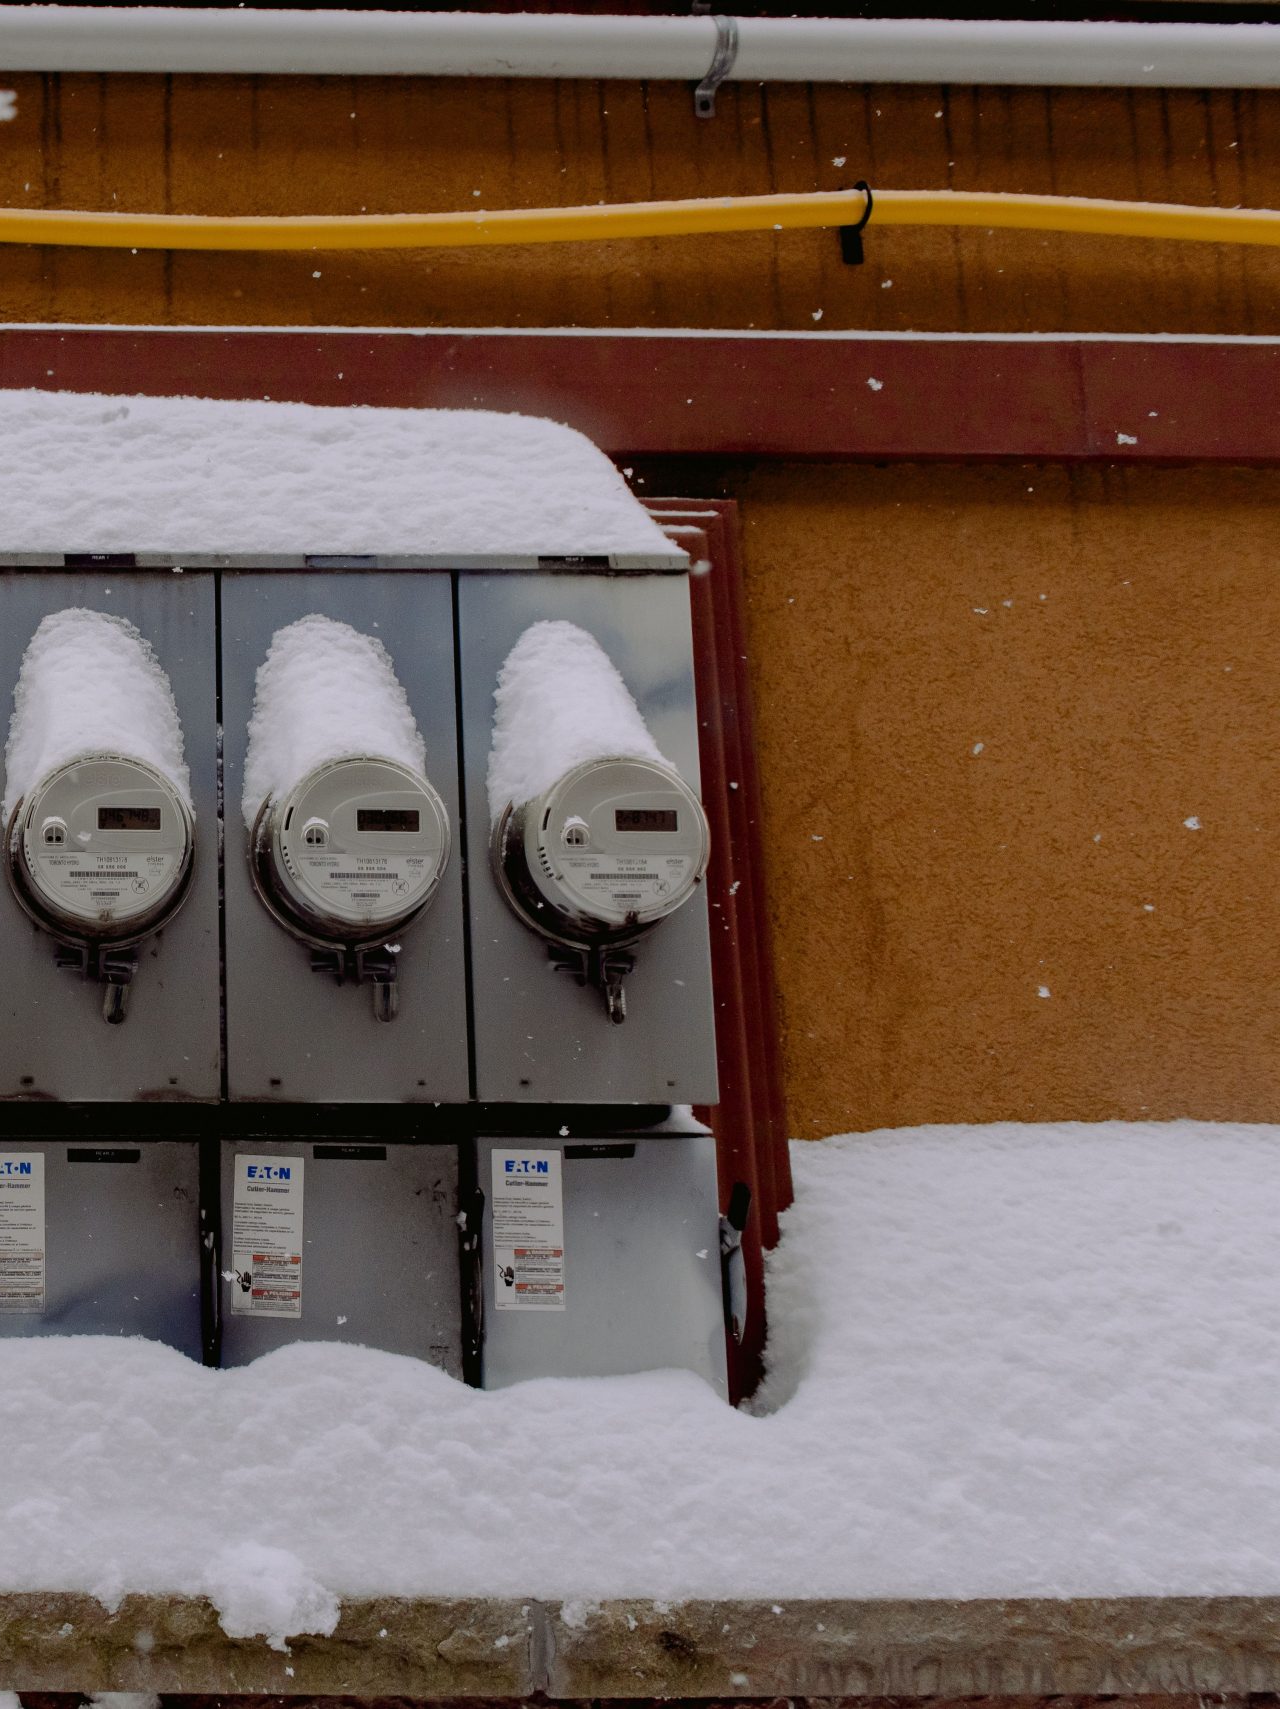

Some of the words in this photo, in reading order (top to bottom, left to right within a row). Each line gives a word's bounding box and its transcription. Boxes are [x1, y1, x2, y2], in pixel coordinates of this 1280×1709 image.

[247, 1165, 291, 1180] EATON
[505, 1160, 548, 1173] EATON
[246, 1185, 290, 1194] Cutler-Hammer
